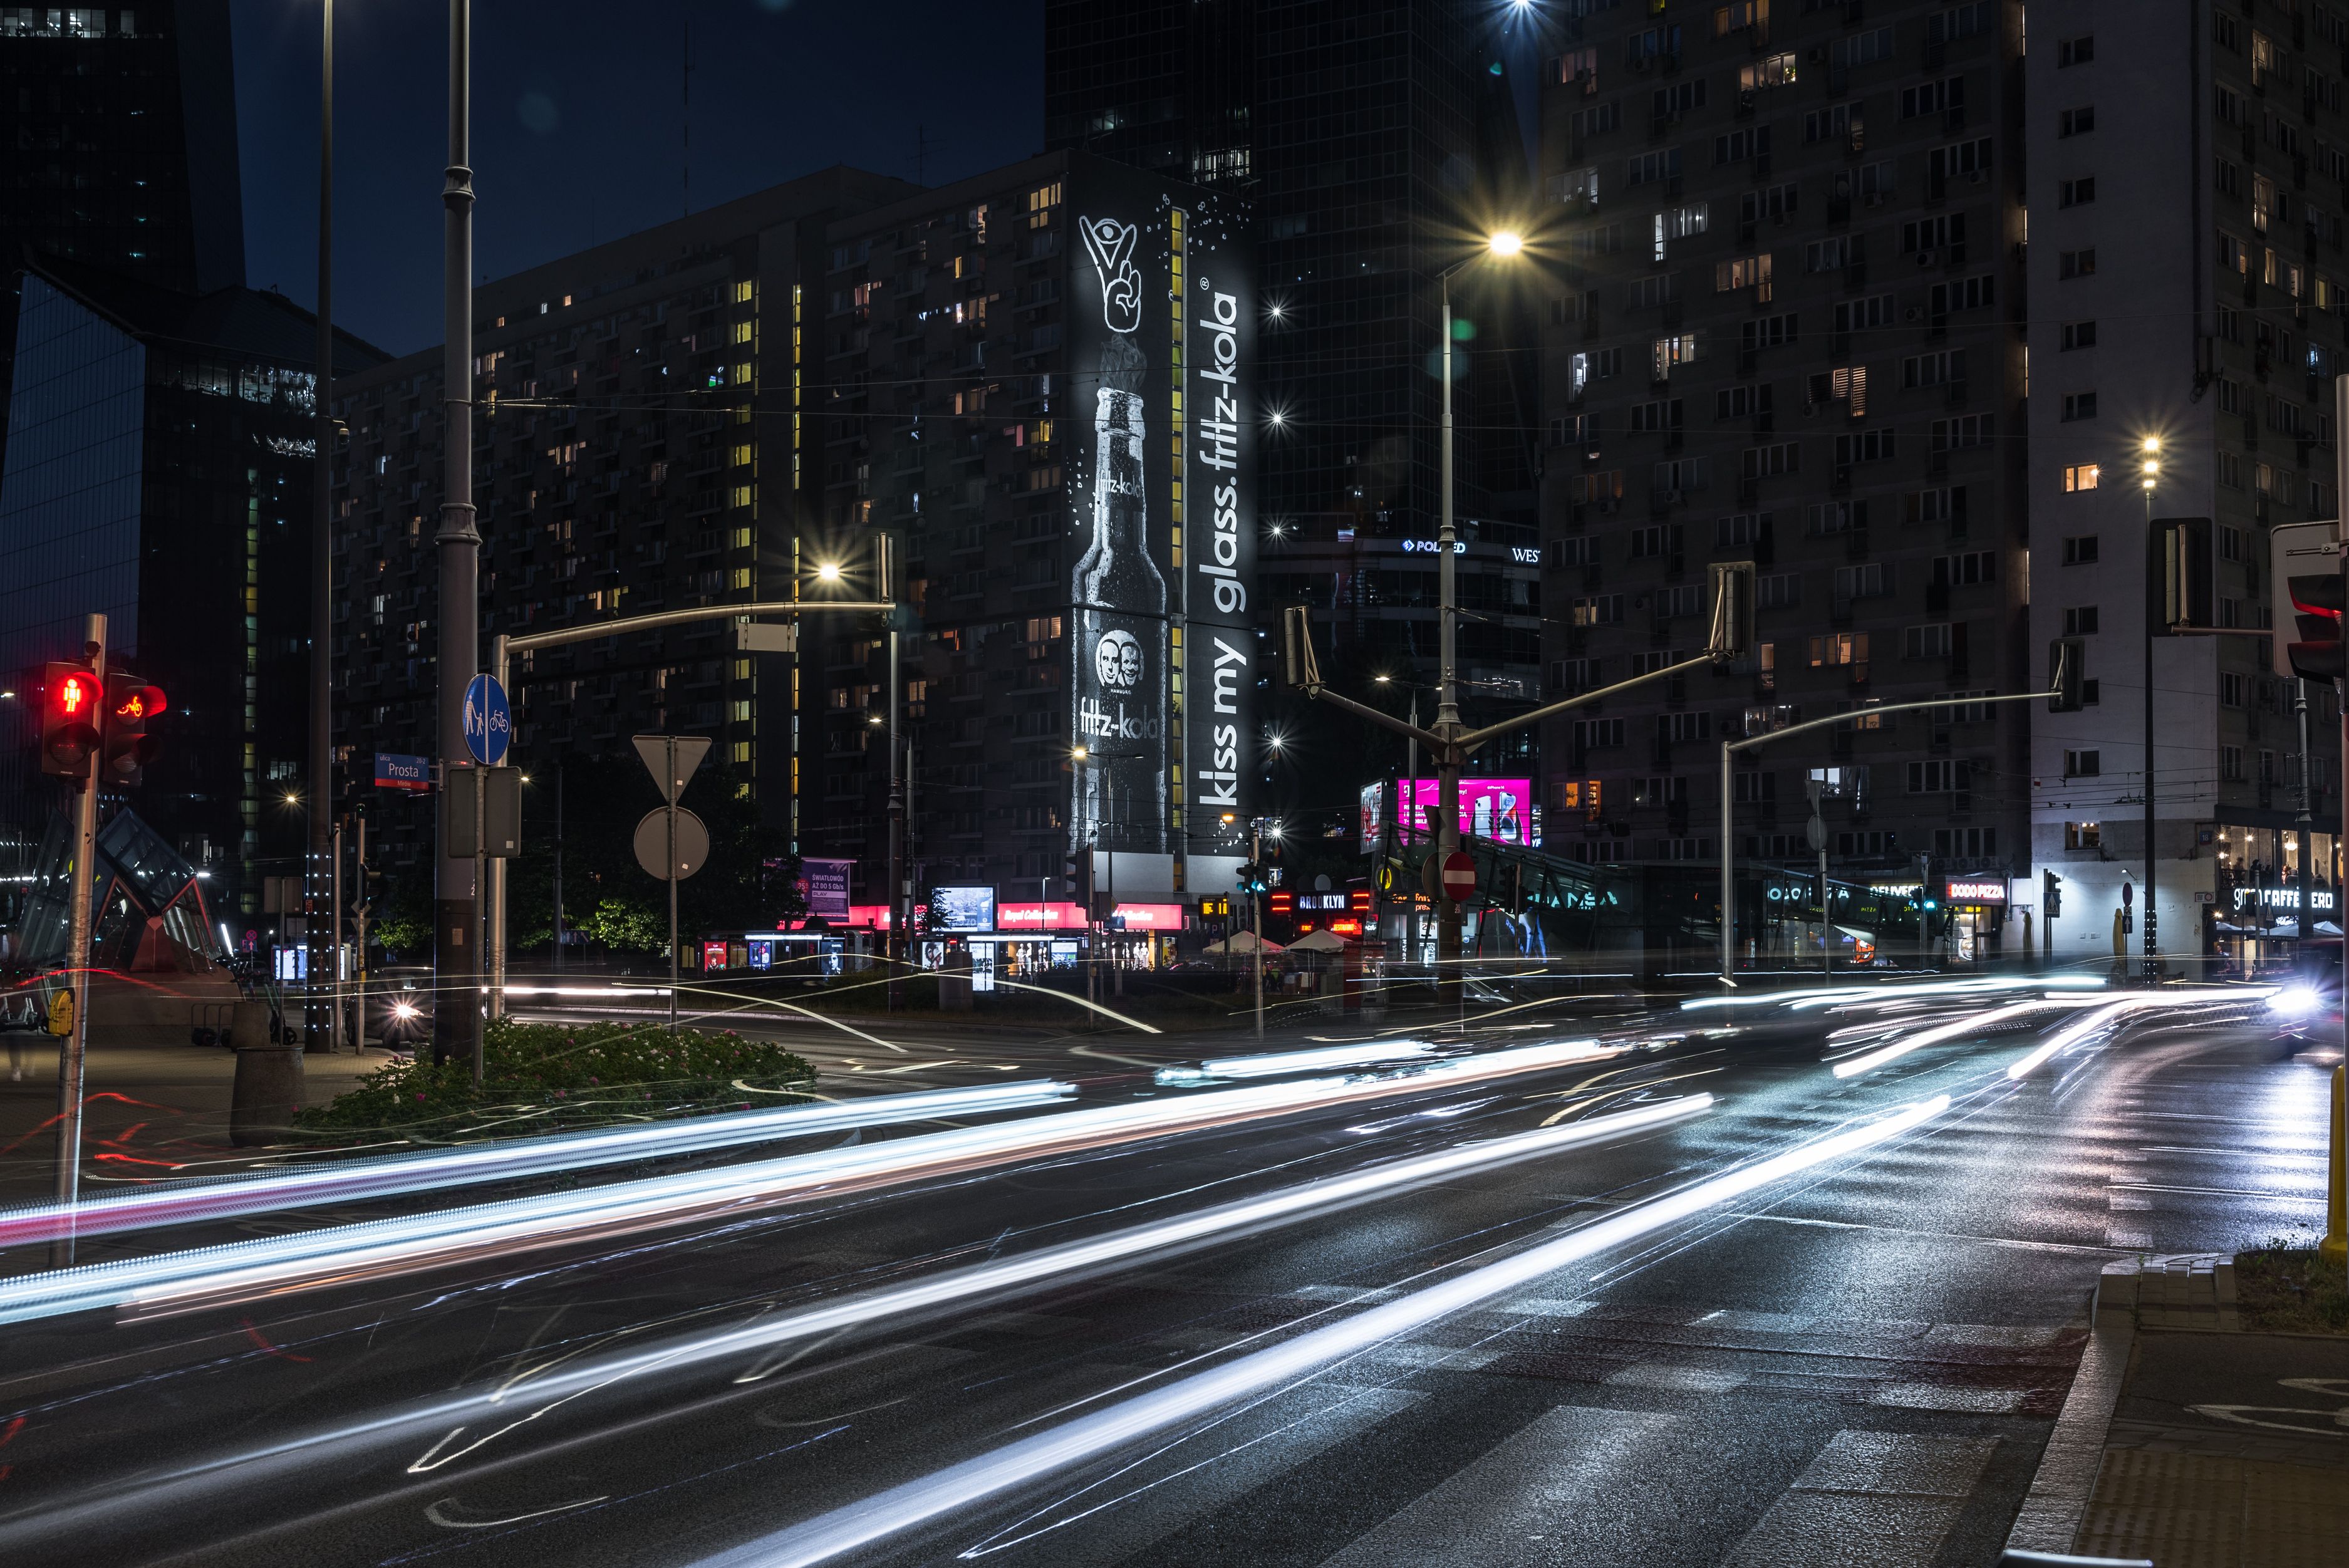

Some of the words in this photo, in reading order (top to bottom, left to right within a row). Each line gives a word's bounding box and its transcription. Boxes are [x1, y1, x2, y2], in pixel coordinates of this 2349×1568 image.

[1199, 476, 1247, 613] glass.
[1416, 541, 1466, 554] POLED
[1512, 548, 1541, 563] WES
[1214, 636, 1247, 714] my
[1080, 696, 1158, 739] fritz-kola
[389, 762, 418, 777] Prosta
[1199, 724, 1237, 806] kiss
[812, 873, 844, 882] ŚWIATŁOWÓD
[1949, 883, 1977, 898] DODO
[1977, 885, 2004, 898] PIZZA
[1299, 895, 1345, 909] BROOKLYN
[2311, 891, 2333, 908] ERO
